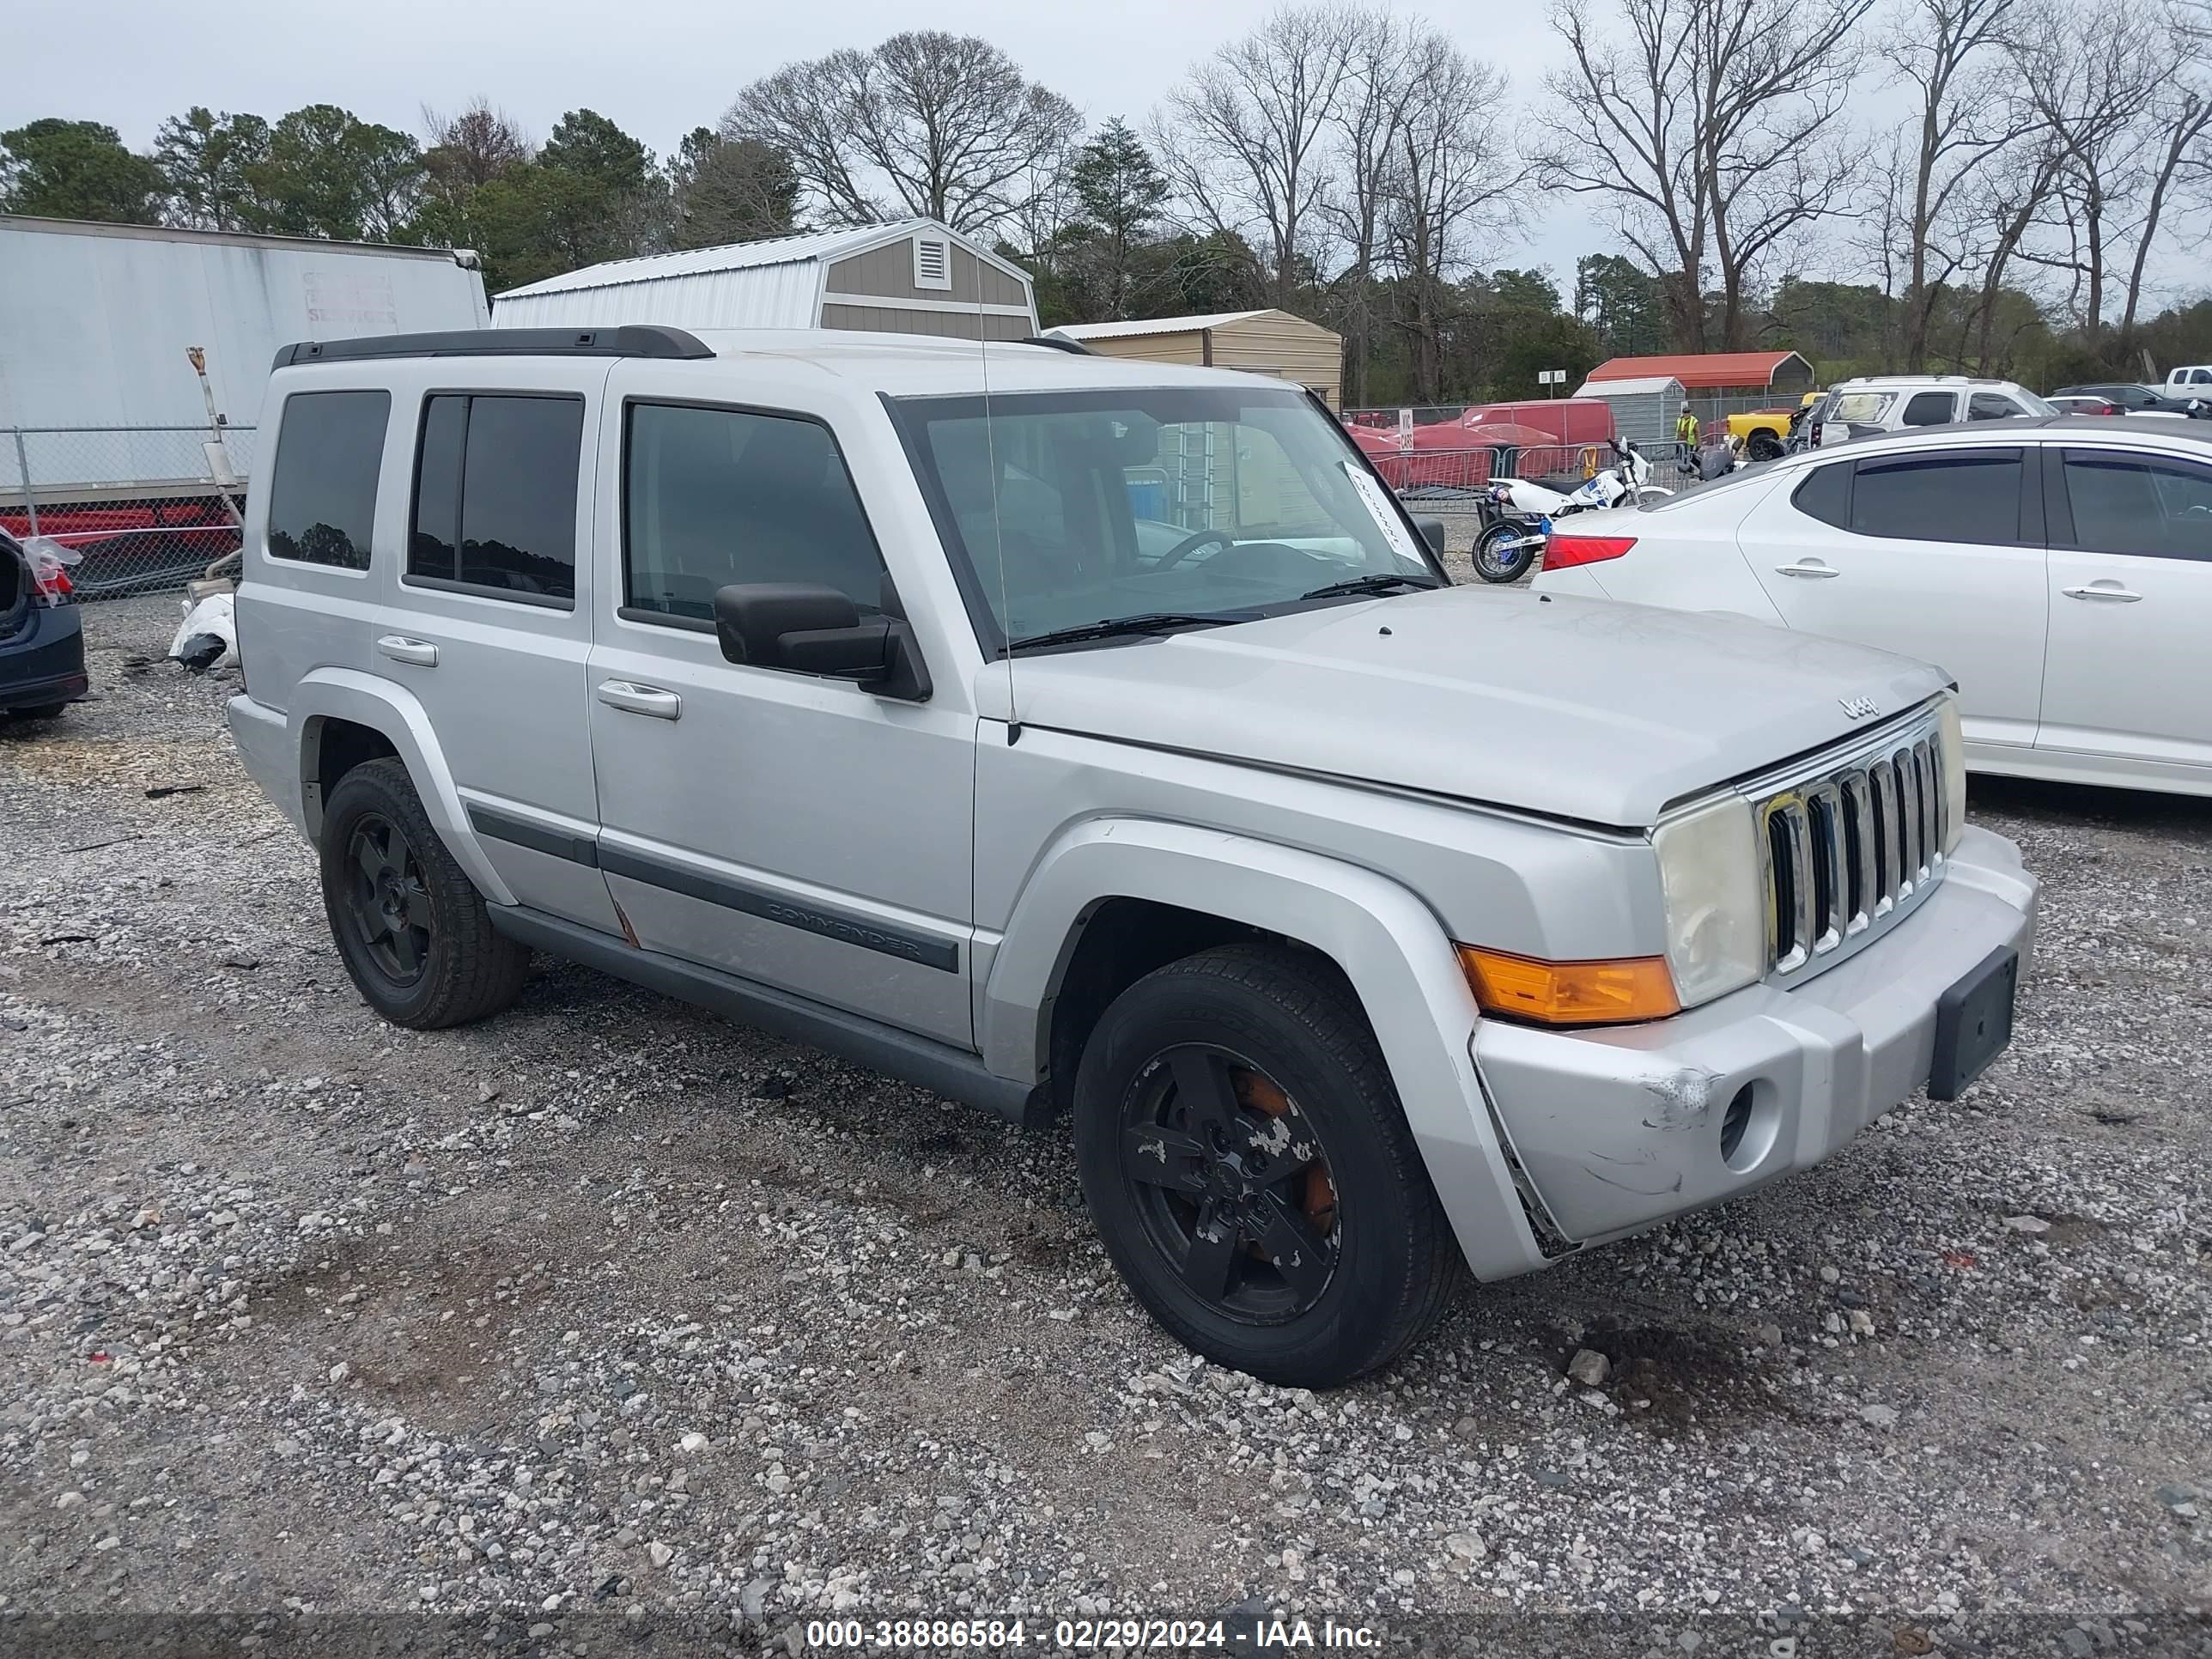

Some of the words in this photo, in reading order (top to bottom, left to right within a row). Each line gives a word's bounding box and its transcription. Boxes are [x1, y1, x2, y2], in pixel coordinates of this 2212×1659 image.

[309, 308, 397, 325] SEVICES
[1556, 371, 1565, 382] A
[1838, 696, 1880, 720] Jeep
[767, 902, 921, 957] COMMANDER
